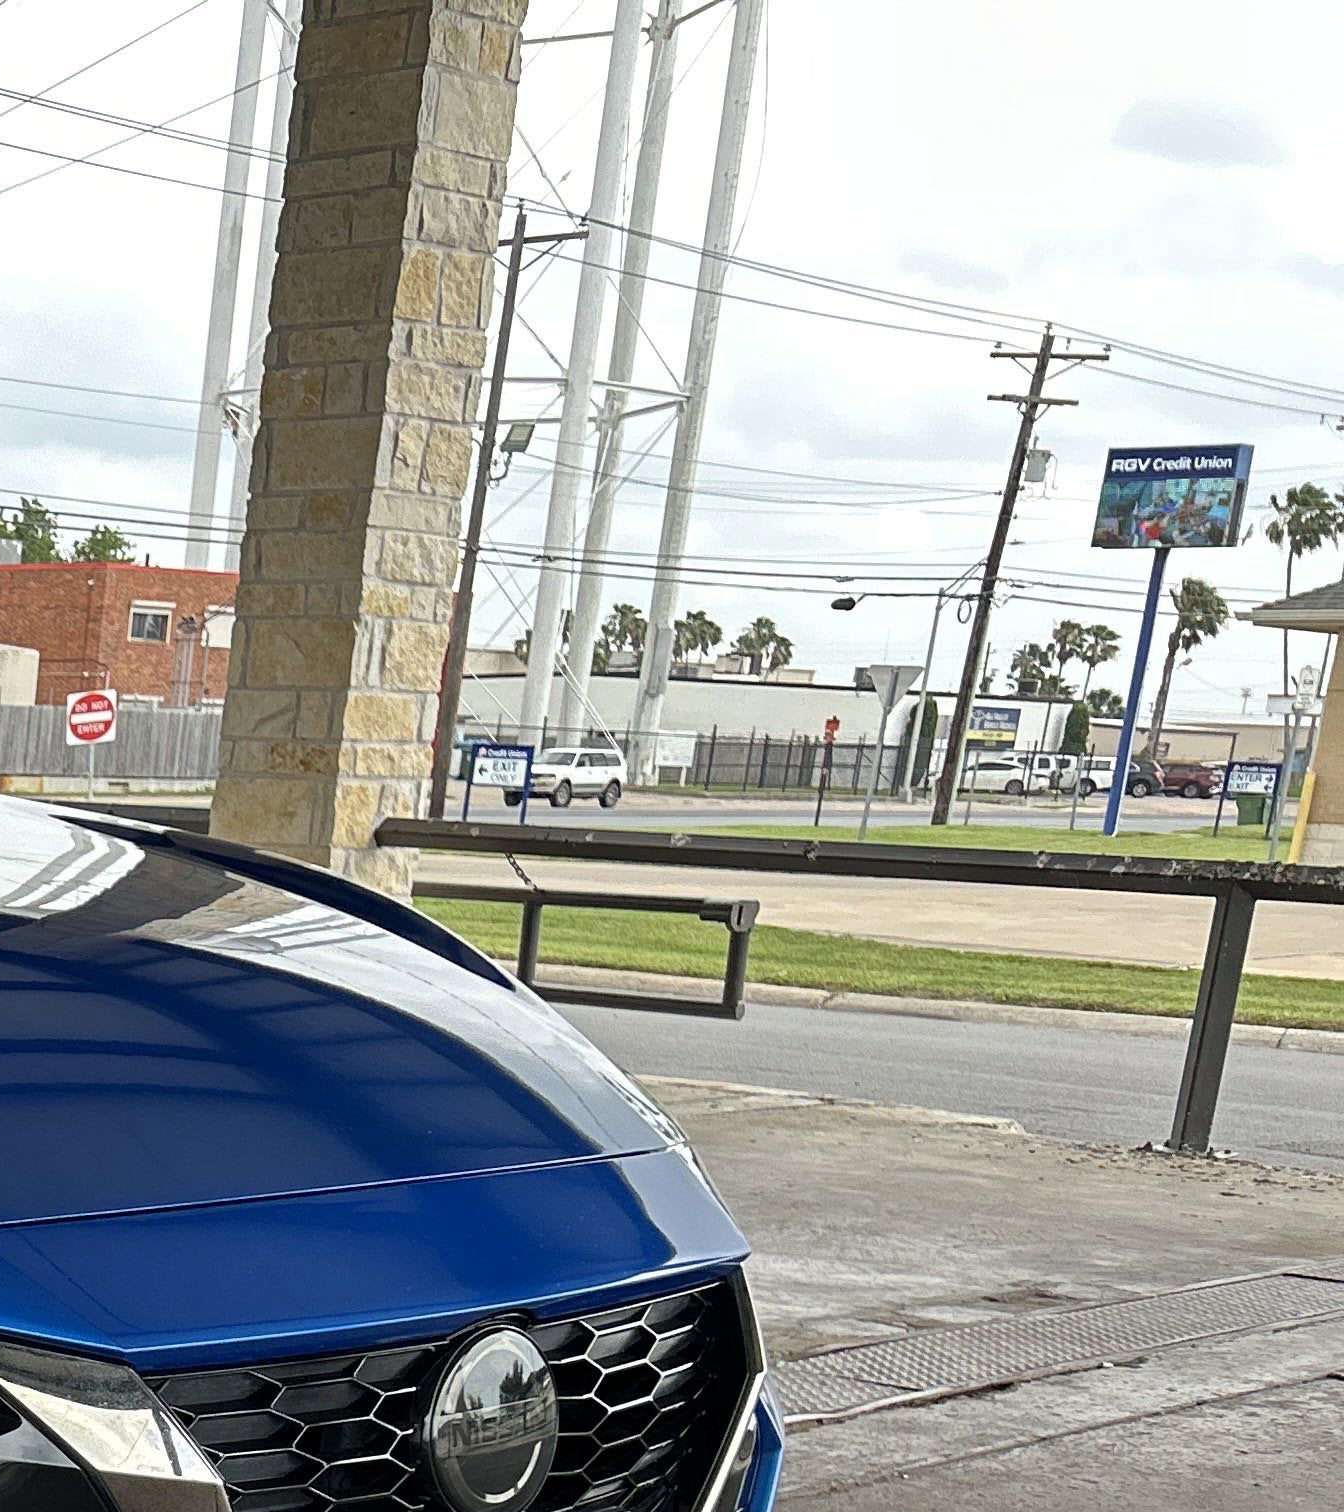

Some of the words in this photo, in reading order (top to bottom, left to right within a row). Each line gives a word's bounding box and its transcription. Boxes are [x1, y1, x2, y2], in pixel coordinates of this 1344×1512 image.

[1111, 457, 1151, 473] RGV
[1152, 456, 1192, 471] Credit
[1194, 455, 1233, 470] Union
[74, 702, 88, 713] DO
[91, 700, 109, 711] NOT
[76, 722, 106, 735] ENTER
[492, 760, 518, 772] EXIT
[1230, 773, 1262, 783] ENTER
